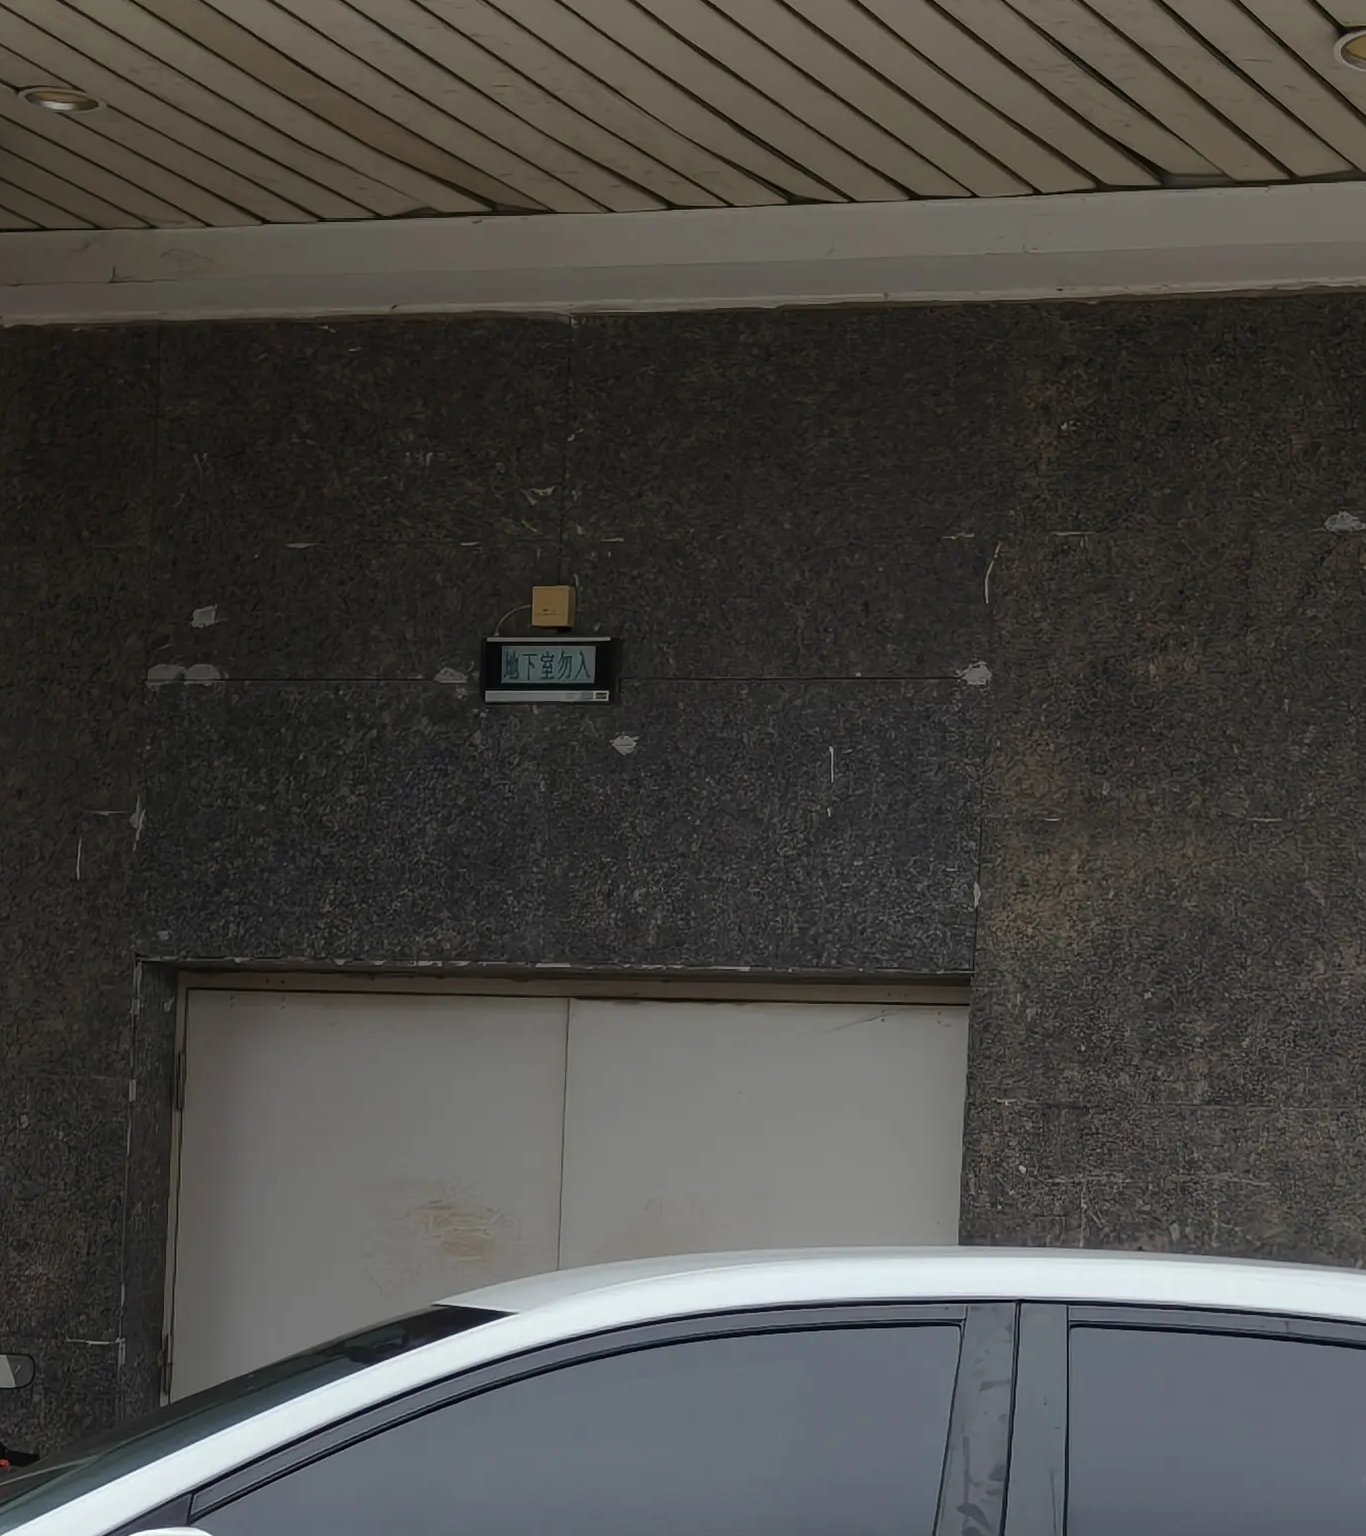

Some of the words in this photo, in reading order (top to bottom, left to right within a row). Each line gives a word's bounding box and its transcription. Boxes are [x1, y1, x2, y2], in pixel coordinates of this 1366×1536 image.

[504, 649, 591, 681] 地下室勿入
